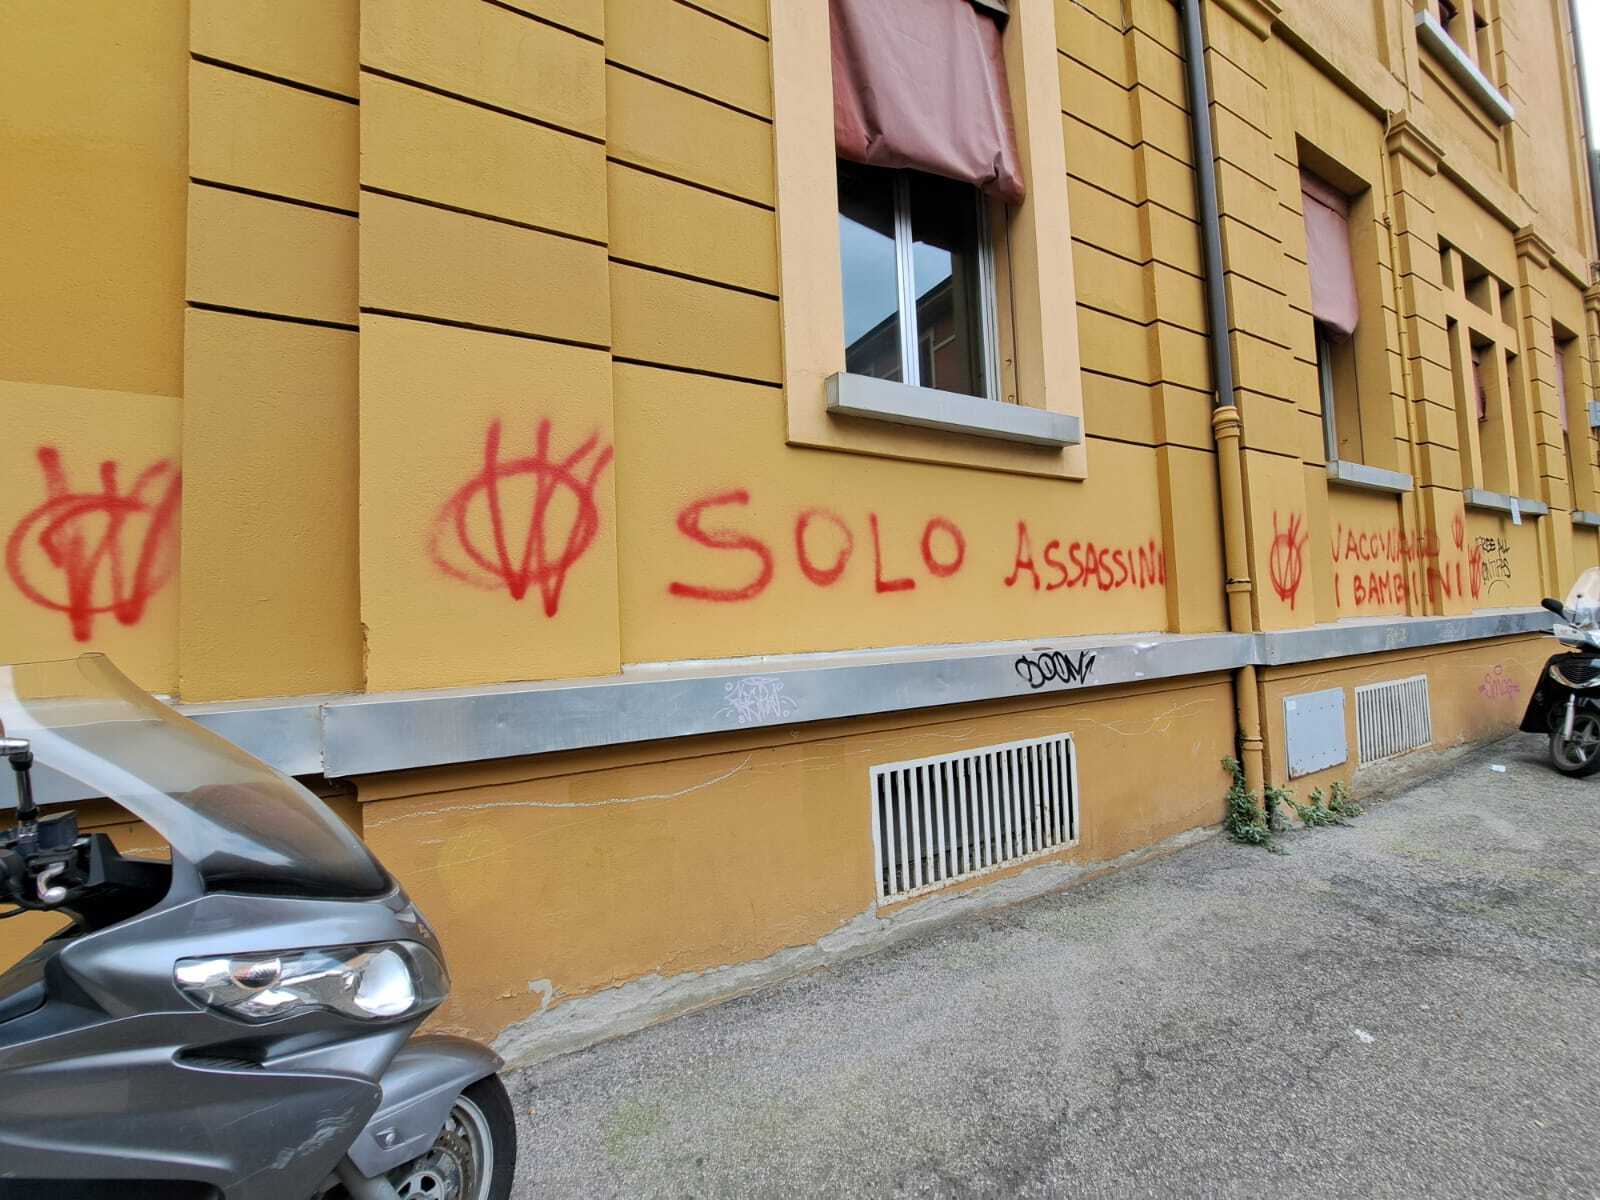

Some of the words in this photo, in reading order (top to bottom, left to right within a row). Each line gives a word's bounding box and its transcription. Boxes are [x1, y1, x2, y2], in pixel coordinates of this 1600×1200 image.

[667, 489, 967, 602] SOLO
[1004, 519, 1168, 592] ASSASSINI
[1333, 572, 1341, 608] I
[1353, 562, 1463, 606] BAMBINI
